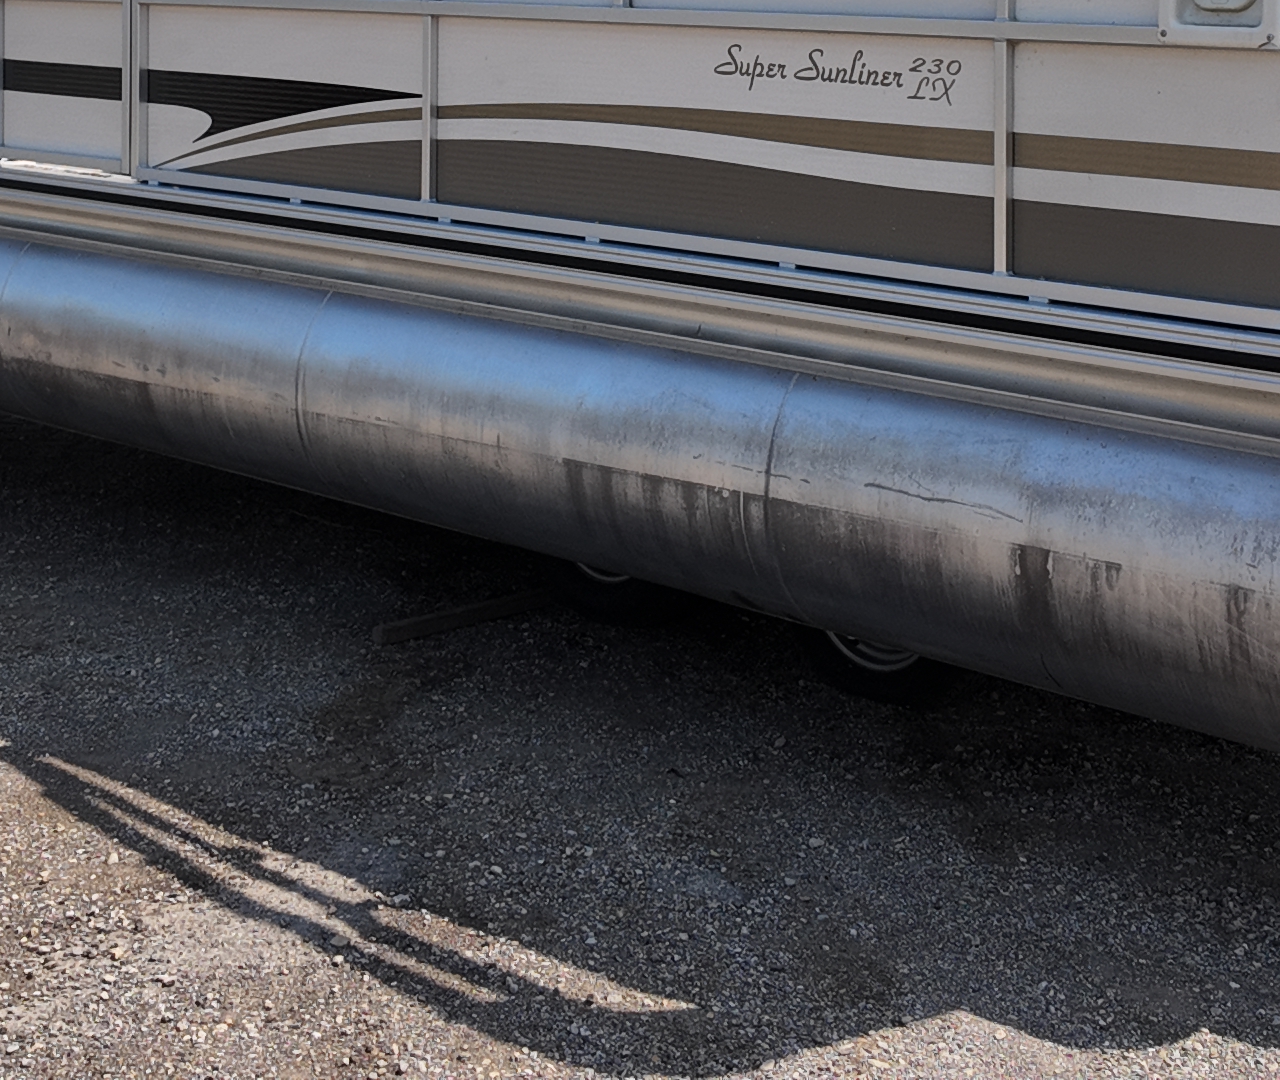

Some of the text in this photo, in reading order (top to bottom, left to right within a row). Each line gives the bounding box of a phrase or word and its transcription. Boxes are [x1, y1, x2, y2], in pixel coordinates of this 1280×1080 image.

[714, 44, 961, 91] Super Sunliner 230
[907, 77, 956, 106] LX
